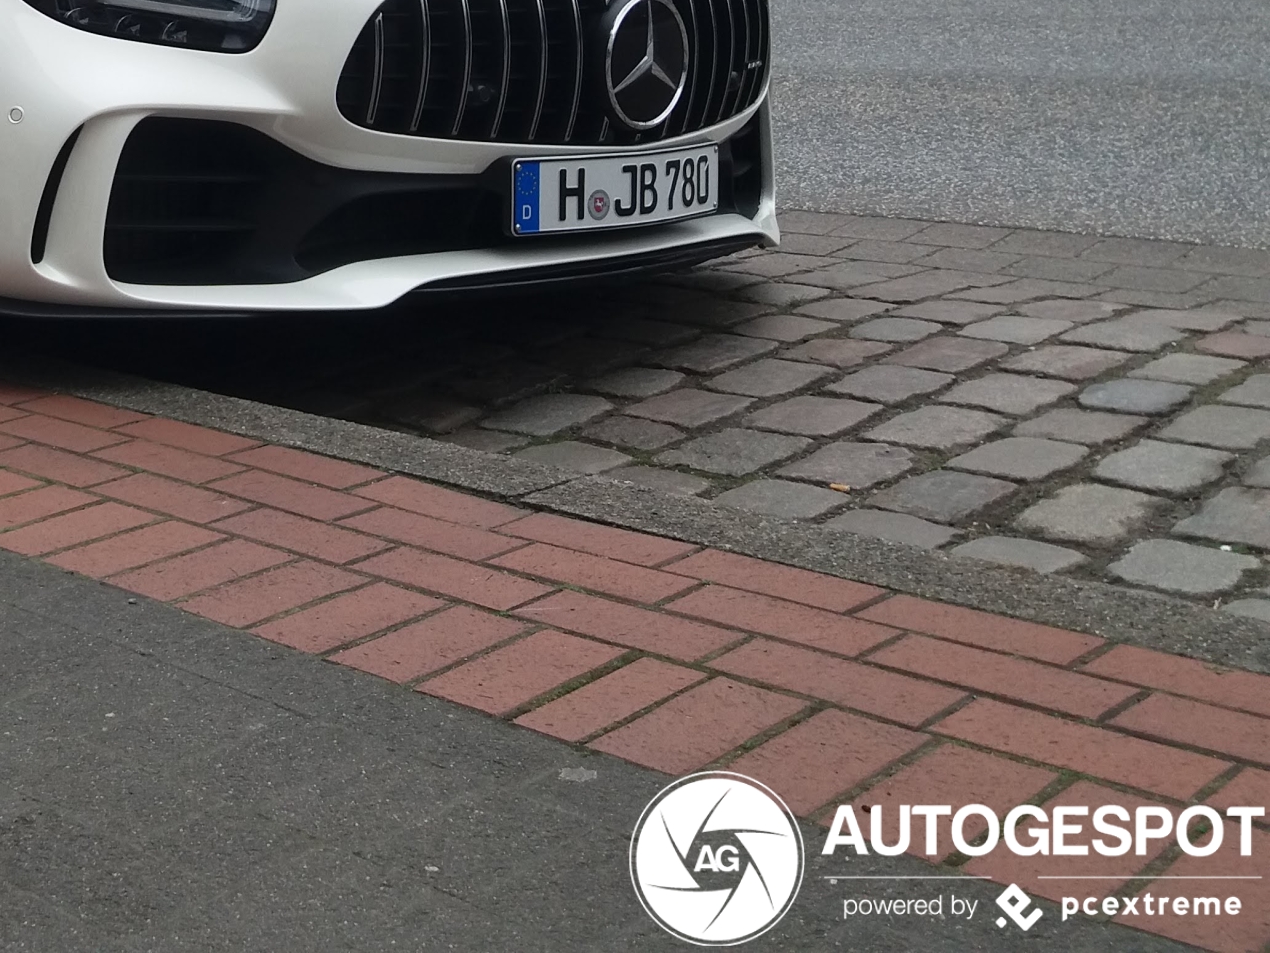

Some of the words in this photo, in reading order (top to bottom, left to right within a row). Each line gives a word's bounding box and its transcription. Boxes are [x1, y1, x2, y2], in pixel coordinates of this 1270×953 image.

[559, 168, 585, 221] H
[614, 163, 658, 217] JB
[665, 154, 710, 211] 780
[522, 204, 532, 220] D
